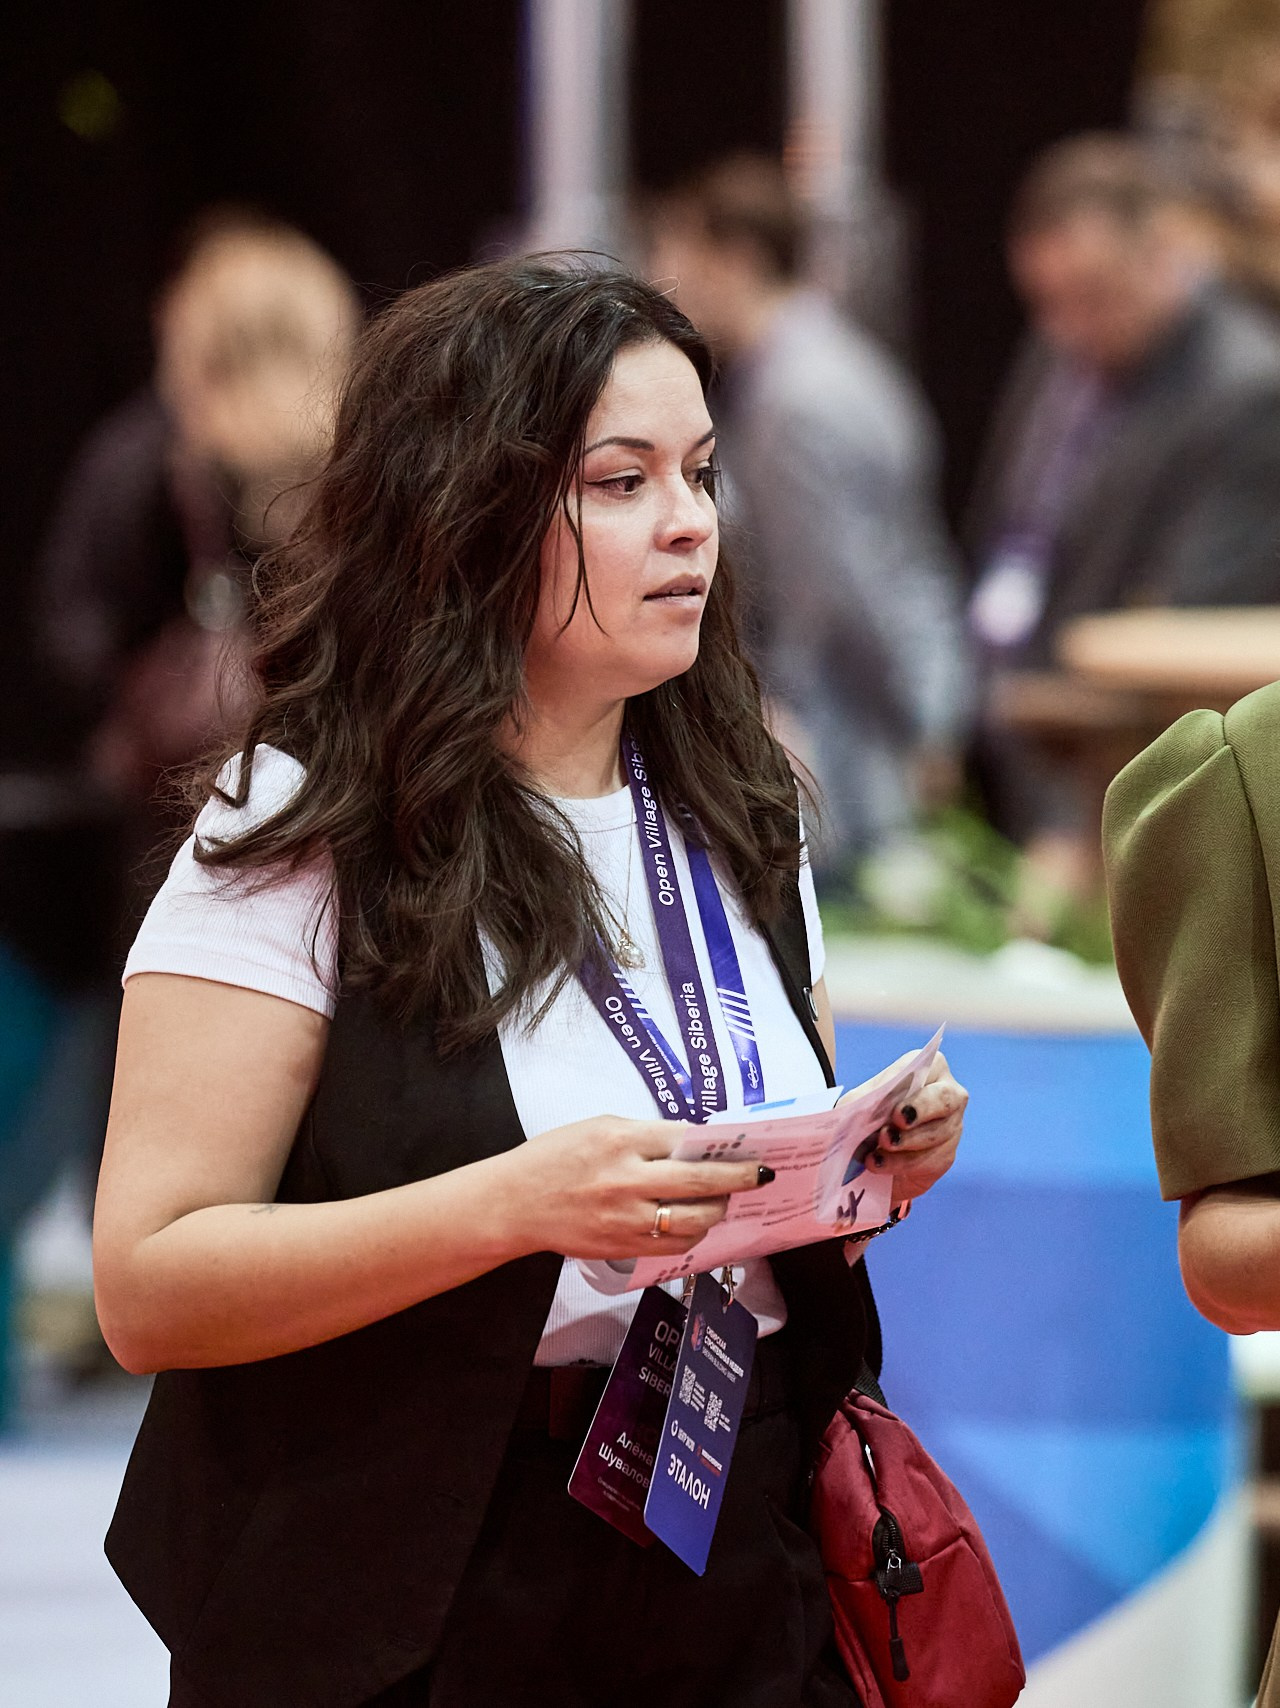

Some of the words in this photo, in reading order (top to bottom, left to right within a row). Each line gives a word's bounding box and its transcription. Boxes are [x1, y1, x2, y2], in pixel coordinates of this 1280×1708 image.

[641, 786, 662, 849] Village
[658, 853, 676, 907] Open
[680, 982, 708, 1050] Siberia
[605, 996, 642, 1049] Open
[639, 1048, 680, 1114] Village
[648, 1343, 677, 1374] VILLA
[655, 1320, 680, 1347] OP
[638, 1366, 672, 1398] SIBER
[598, 1442, 651, 1489] Шувалов
[616, 1431, 653, 1468] Алёна
[667, 1453, 711, 1510] ЭТАЛОН
